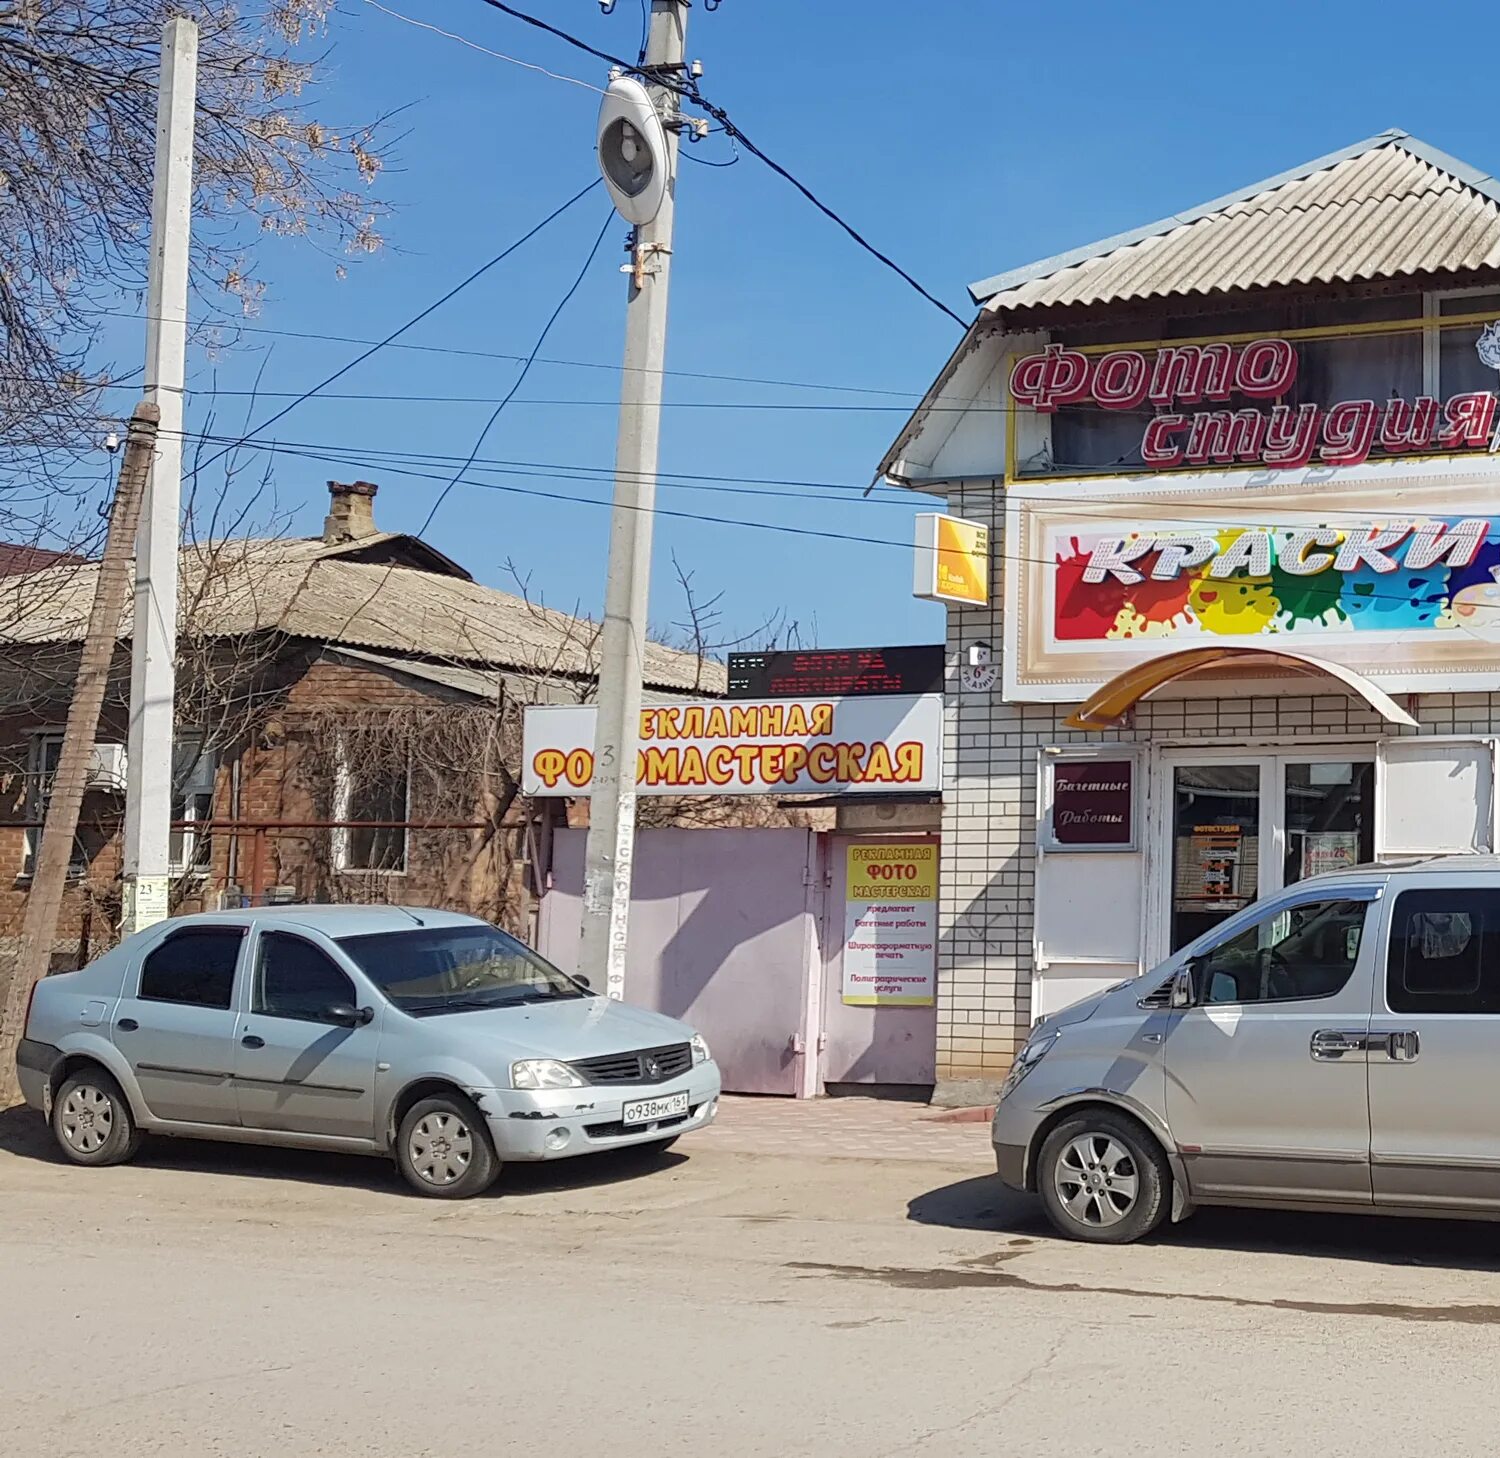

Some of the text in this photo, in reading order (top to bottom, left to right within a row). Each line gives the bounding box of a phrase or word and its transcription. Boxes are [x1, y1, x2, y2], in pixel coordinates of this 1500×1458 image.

[1082, 519, 1490, 585] КРАСКИ
[640, 704, 833, 739] ЕКЛАМНАЯ
[533, 741, 923, 788] ФОМАСТЕРСКАЯ
[1056, 779, 1128, 791] Багетные
[1060, 809, 1124, 825] Работы
[853, 848, 931, 860] РЕКЛАМНАЯ
[867, 864, 917, 880] ФОТО
[140, 884, 152, 895] 23
[853, 885, 931, 897] МАСТЕРСКАЯ
[896, 919, 926, 928] работы
[874, 985, 902, 993] услуги
